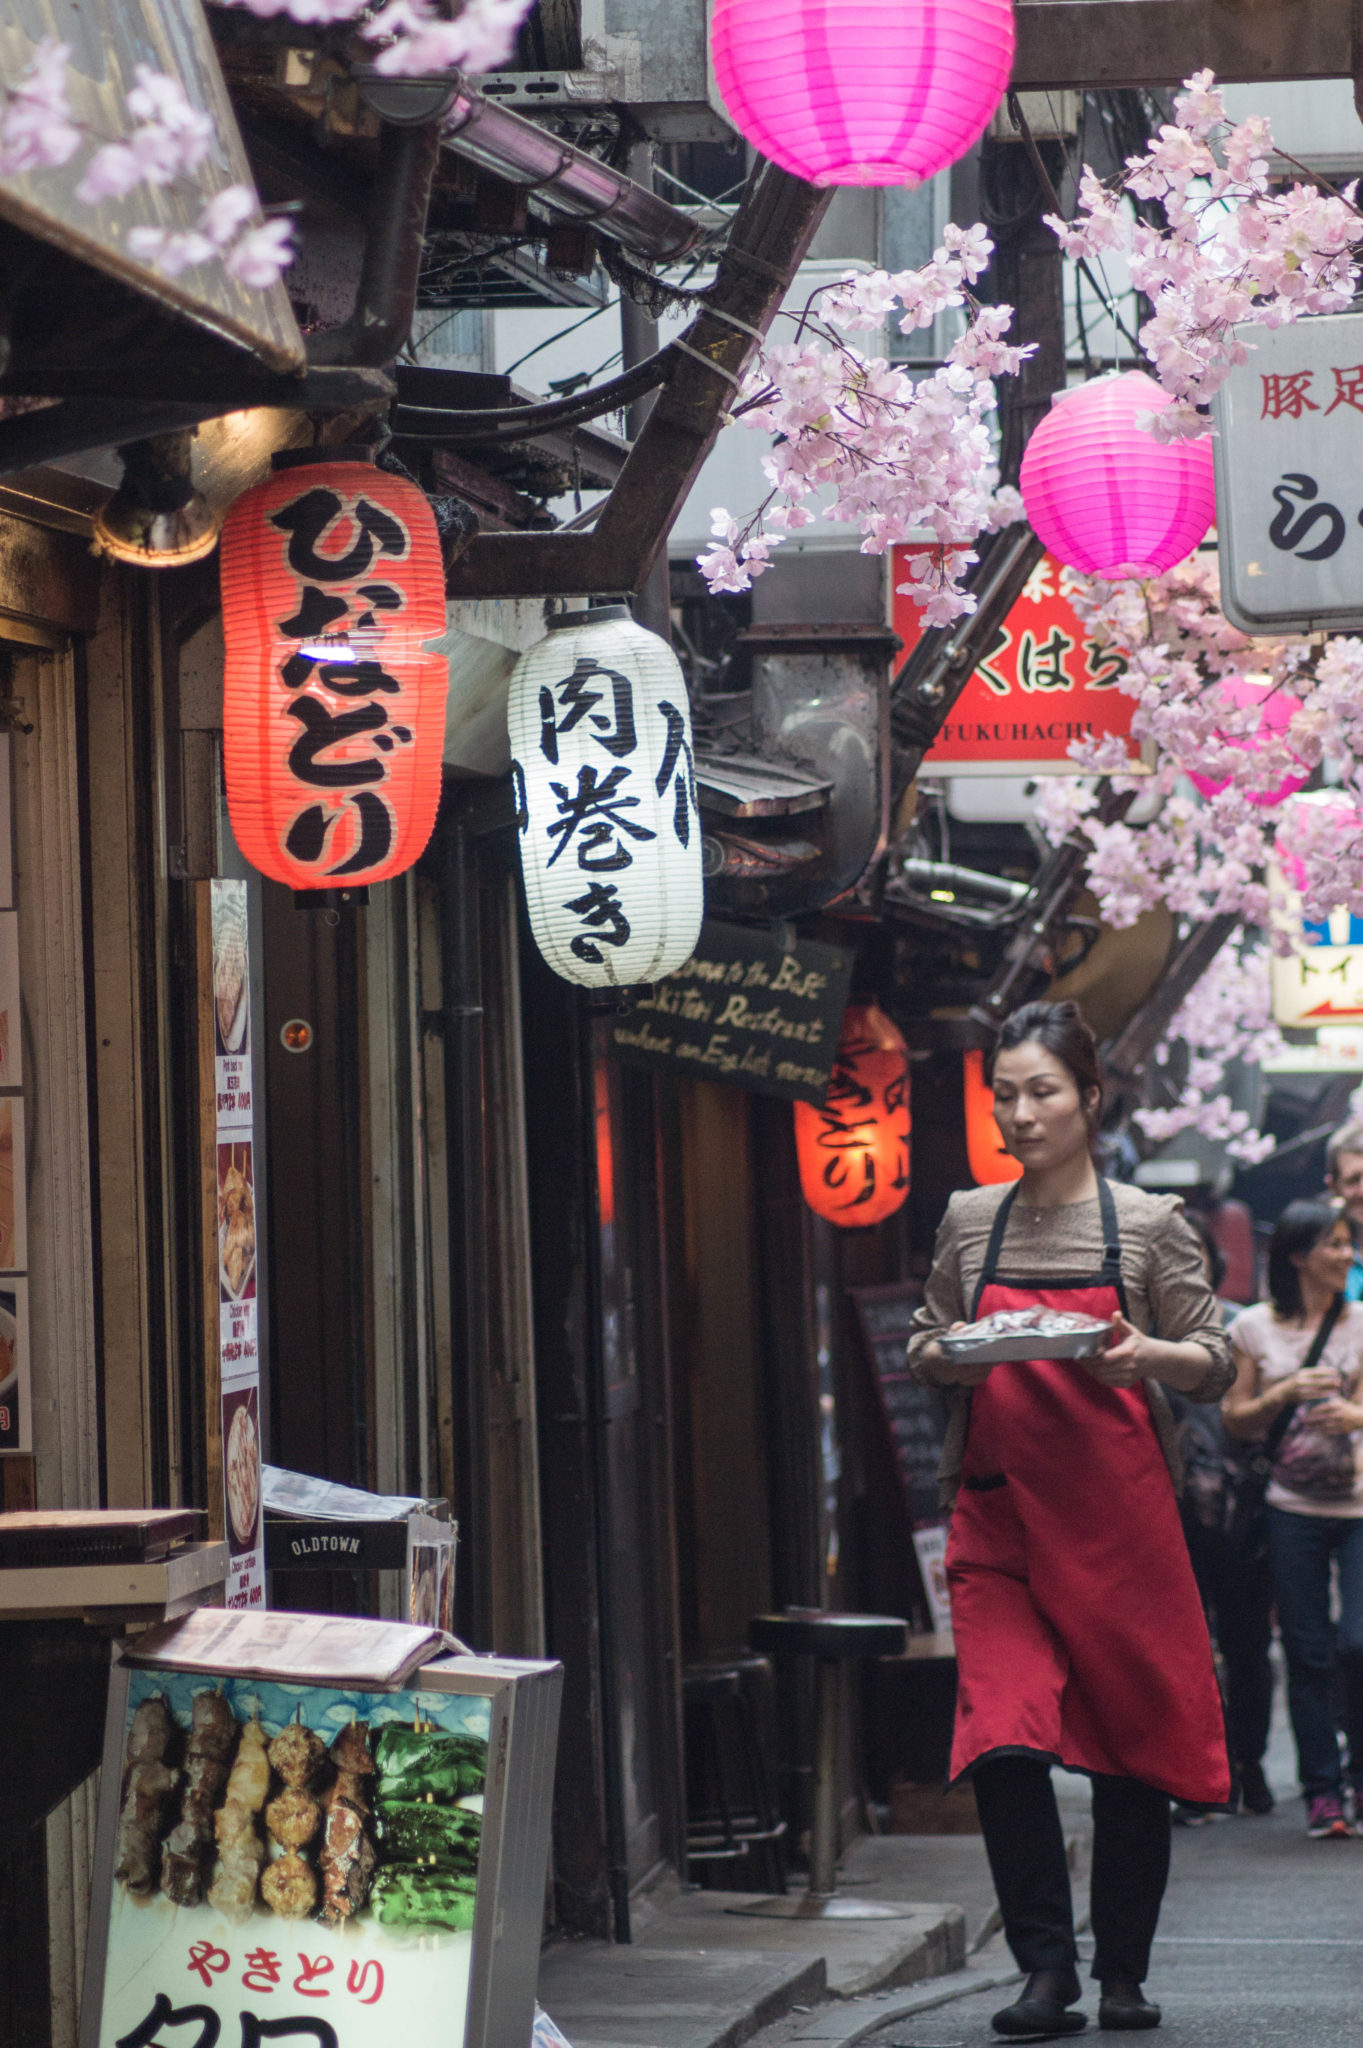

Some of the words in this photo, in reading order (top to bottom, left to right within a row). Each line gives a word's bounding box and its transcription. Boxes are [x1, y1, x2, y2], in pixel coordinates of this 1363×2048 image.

[1269, 473, 1363, 562] ら
[267, 485, 415, 876] ひなどり
[973, 625, 1130, 695] くはち
[943, 722, 1093, 742] FUKUHACHI
[538, 656, 658, 965] 肉巻き
[291, 1535, 361, 1556] OLDTOWN
[187, 1940, 384, 2004] やきとり
